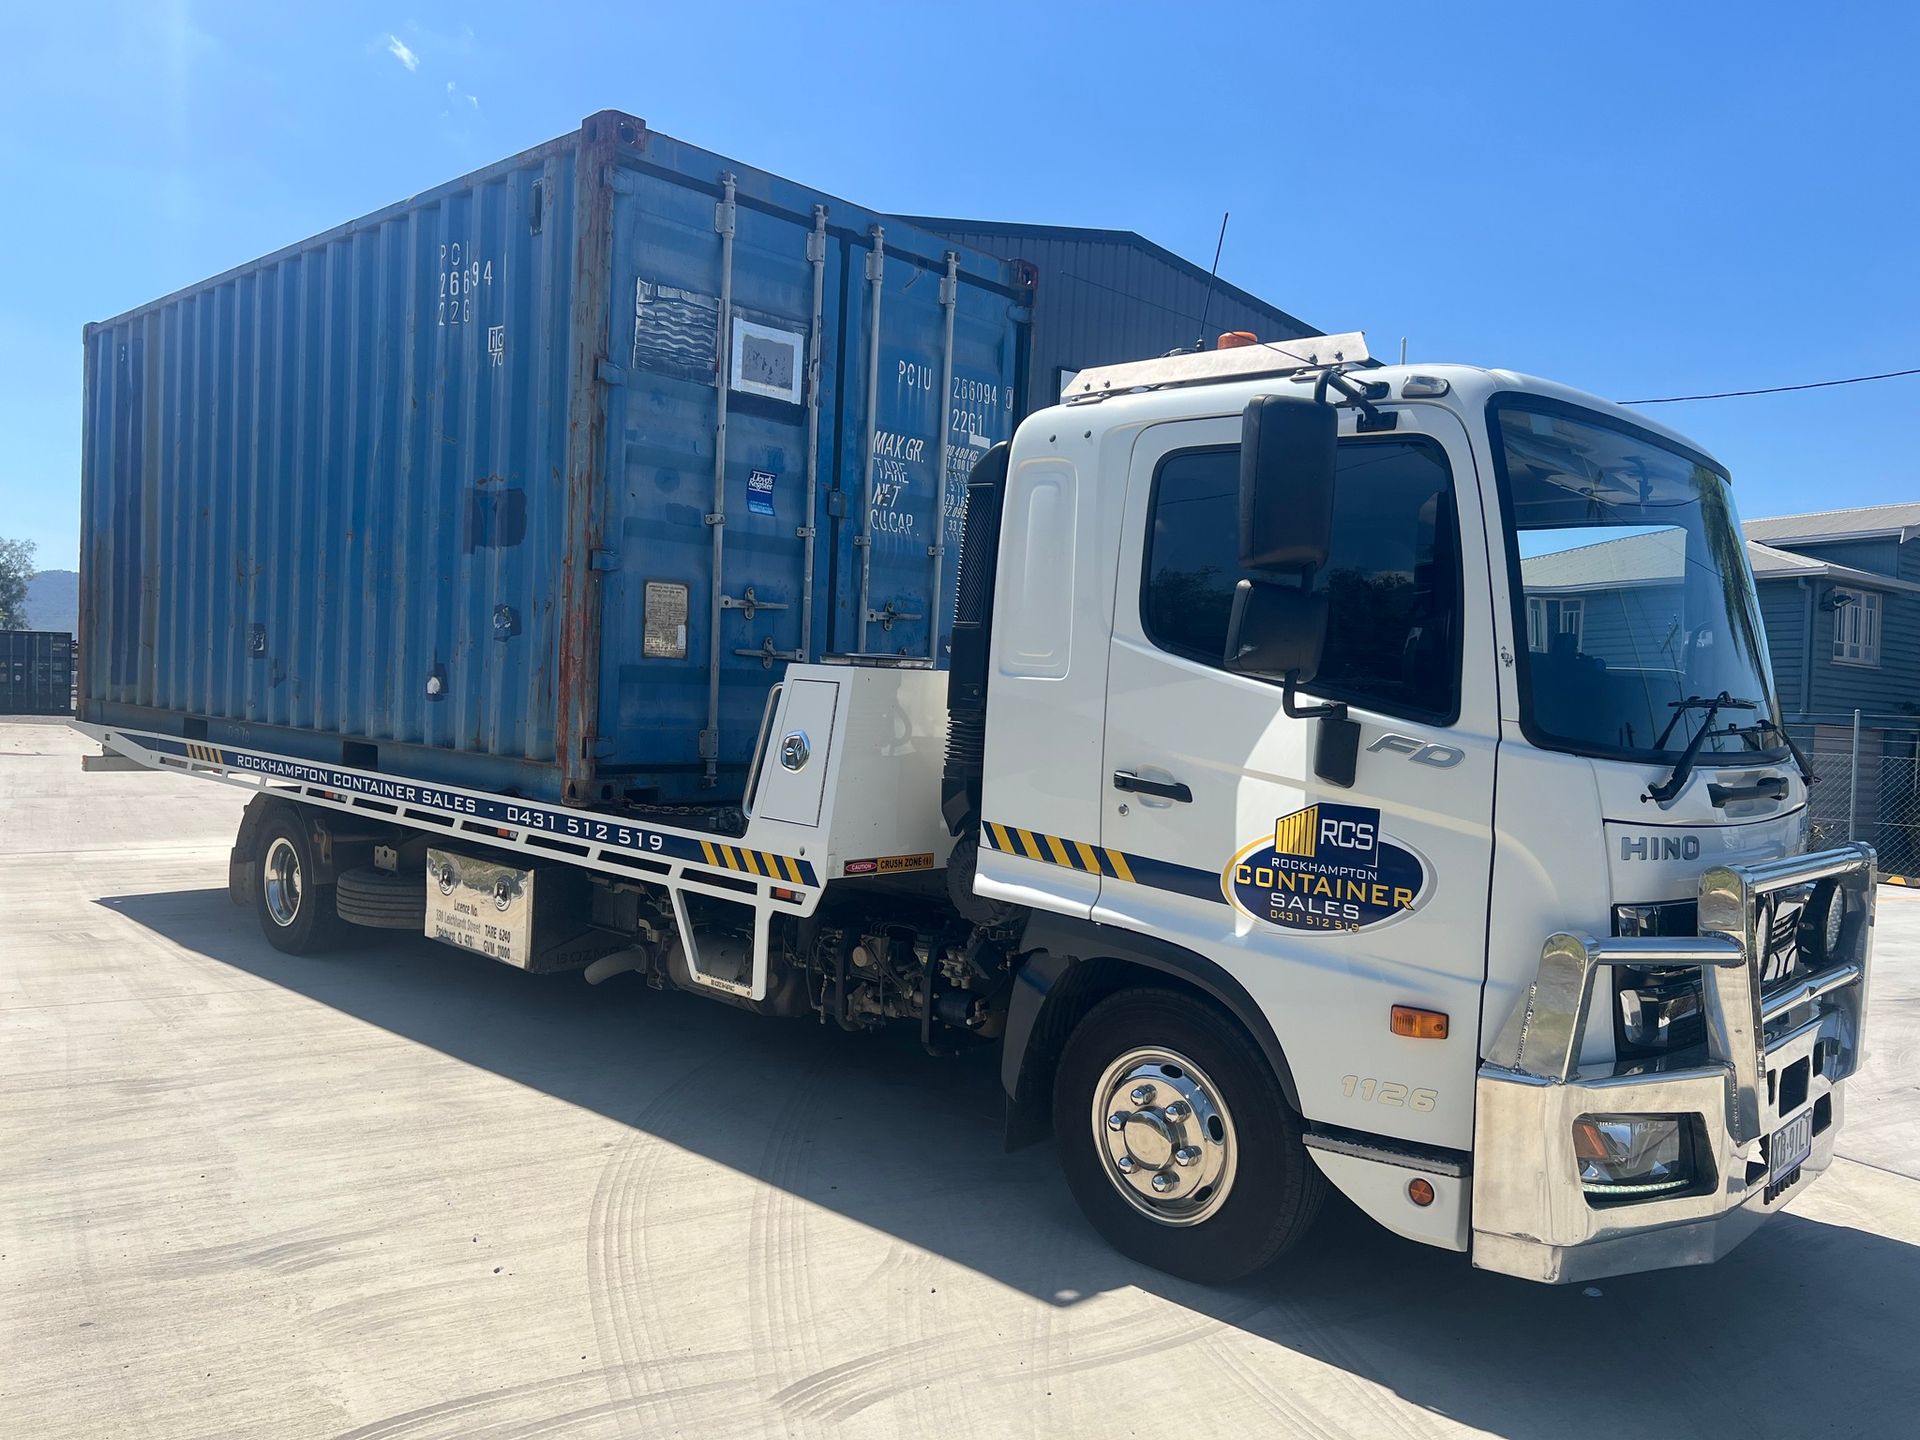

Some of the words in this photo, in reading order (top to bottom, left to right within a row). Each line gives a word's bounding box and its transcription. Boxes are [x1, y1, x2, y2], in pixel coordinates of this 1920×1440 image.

[898, 359, 932, 391] PCIU
[953, 377, 997, 406] 266094
[952, 408, 983, 436] 22G1
[873, 457, 909, 484] TARE
[872, 482, 901, 508] NET
[1366, 732, 1466, 769] FD
[237, 754, 328, 784] ROCKHAMPTON
[333, 773, 416, 801] CONTAINER
[422, 790, 476, 813] SALES
[507, 807, 554, 829] 0431
[567, 818, 607, 840] 512
[618, 828, 663, 850] 519
[1320, 819, 1374, 850] RCS
[1621, 835, 1700, 861] HINO
[851, 863, 872, 871] CAUTION
[880, 859, 903, 870] CRUSH
[904, 857, 922, 868] ZONE
[1271, 857, 1377, 881] ROCKHAMPTON
[1235, 863, 1415, 911] CONTAINER
[453, 898, 470, 915] Licence
[1270, 892, 1360, 920] SALES
[485, 924, 497, 939] TARE
[1270, 909, 1300, 922] 0431
[1306, 915, 1330, 927] 512
[1334, 920, 1360, 933] 519
[483, 940, 495, 954] GVM
[1342, 1074, 1439, 1113] 1126
